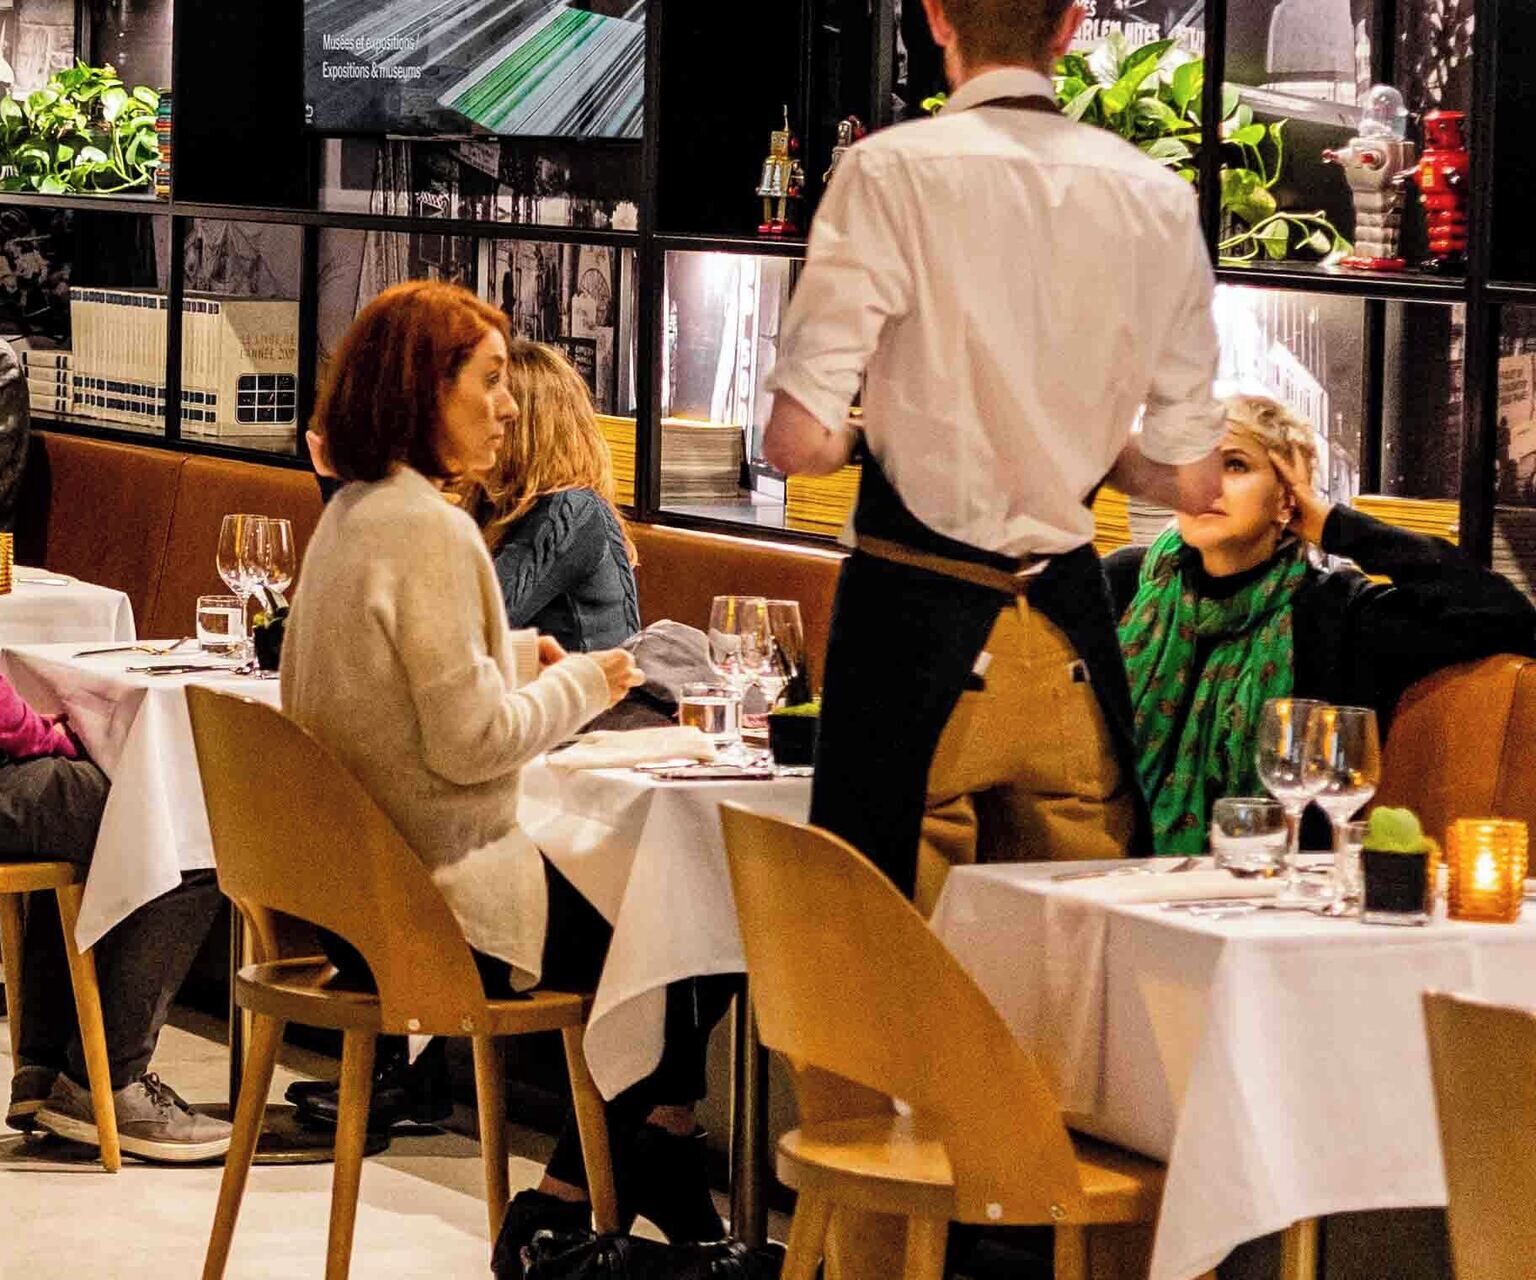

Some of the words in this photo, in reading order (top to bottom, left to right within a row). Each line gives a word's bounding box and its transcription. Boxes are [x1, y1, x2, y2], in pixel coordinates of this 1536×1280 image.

[322, 33, 355, 51] Musées
[355, 35, 365, 51] et
[366, 33, 416, 54] expositions
[322, 61, 370, 80] Expositions
[370, 61, 379, 79] &
[379, 65, 422, 79] museums
